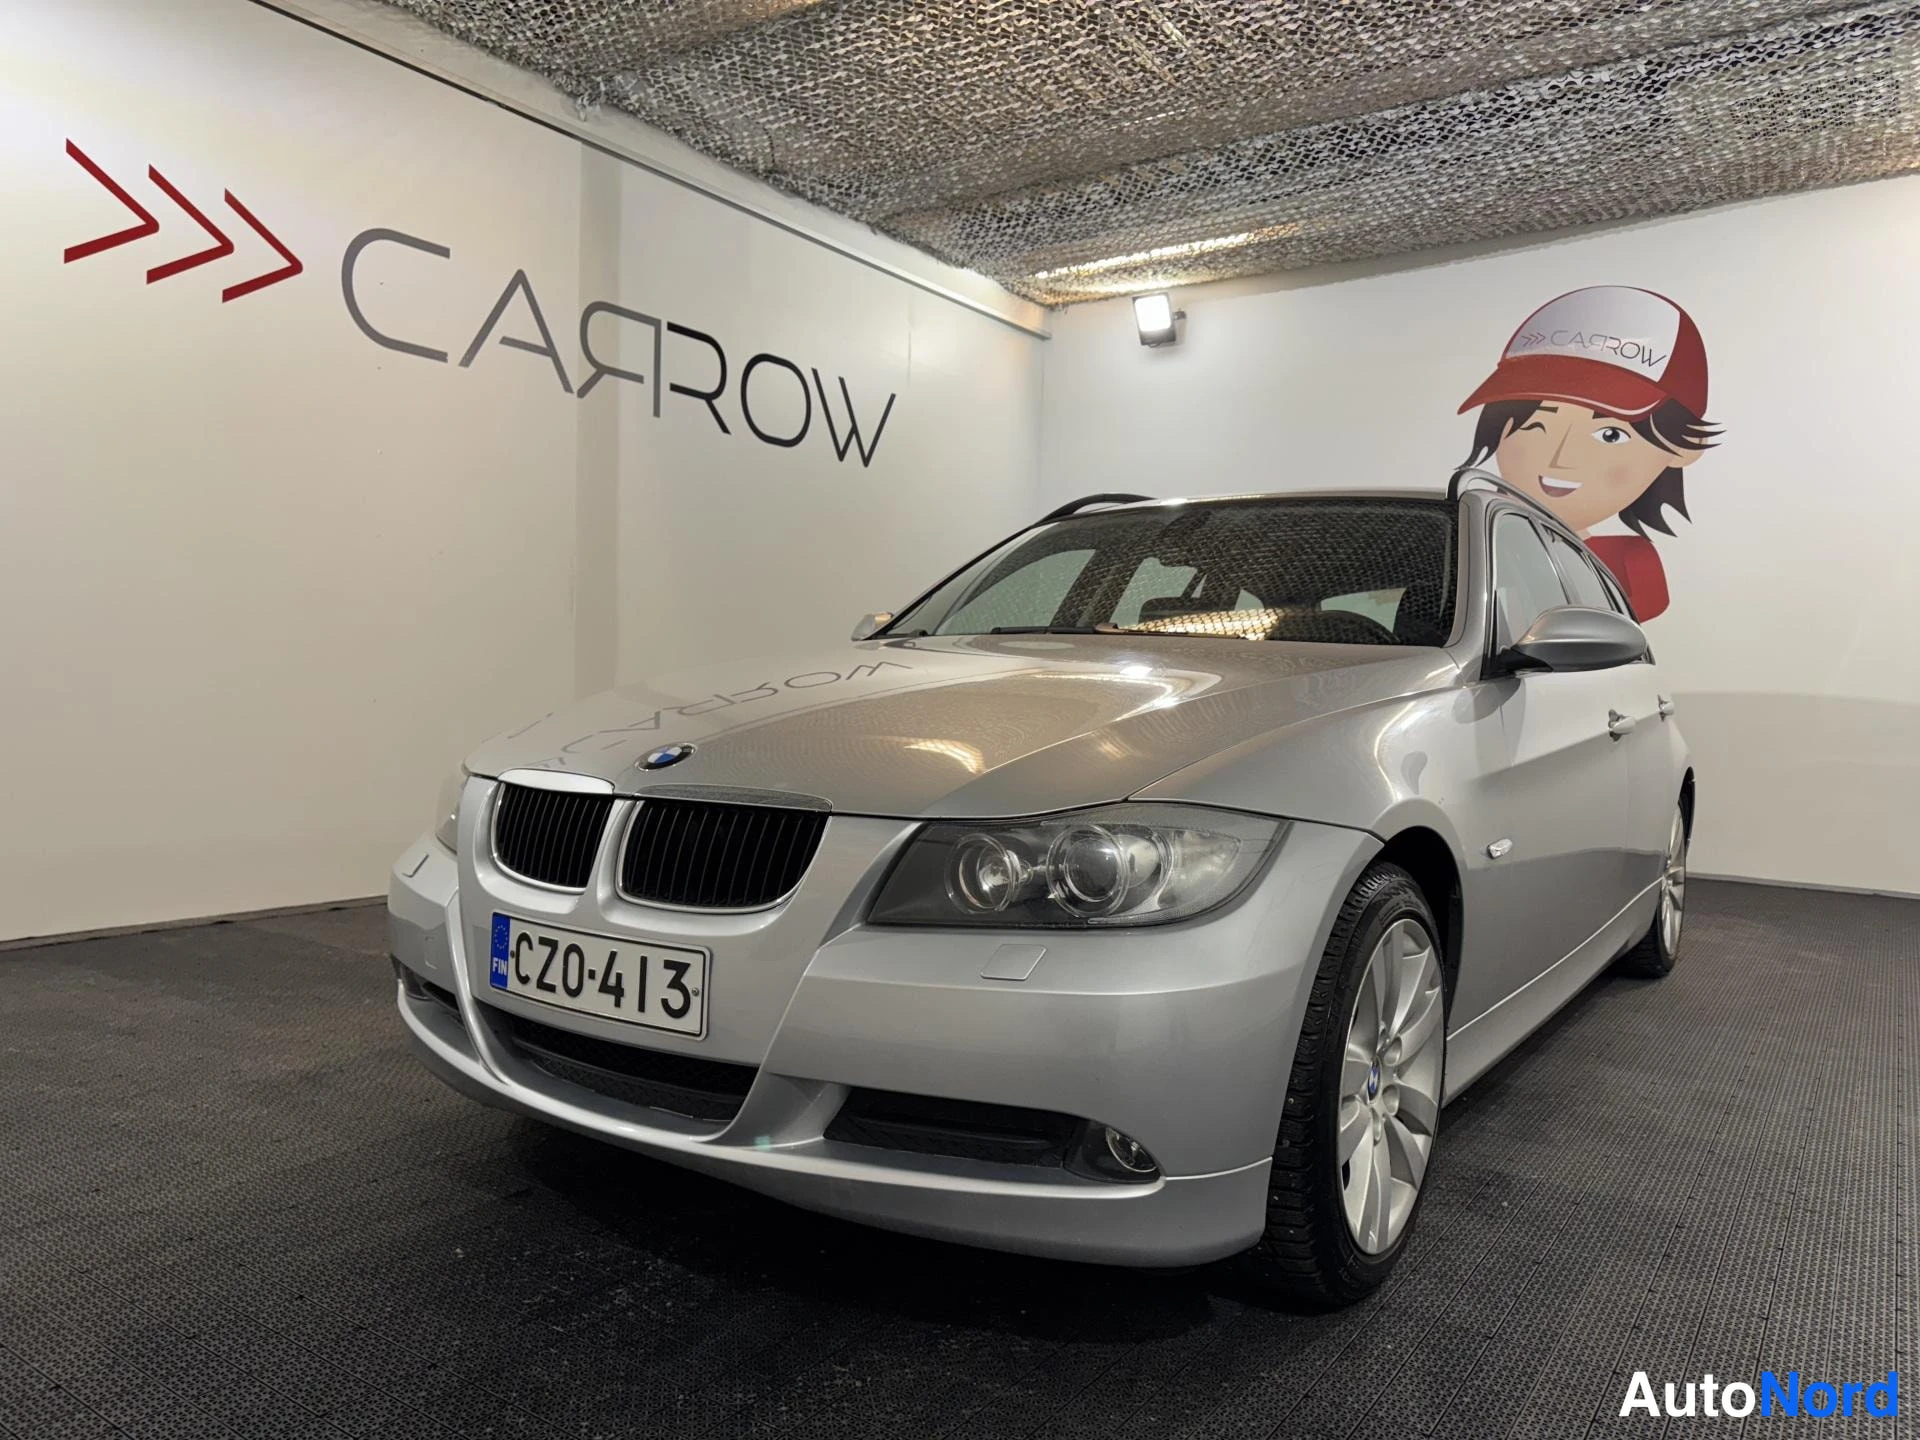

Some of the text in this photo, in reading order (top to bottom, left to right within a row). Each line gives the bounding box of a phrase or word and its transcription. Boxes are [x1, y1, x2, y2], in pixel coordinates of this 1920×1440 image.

[341, 227, 896, 468] CARROW
[1550, 329, 1667, 367] CARROW
[492, 957, 508, 976] FIN
[515, 932, 691, 1019] CZO-413
